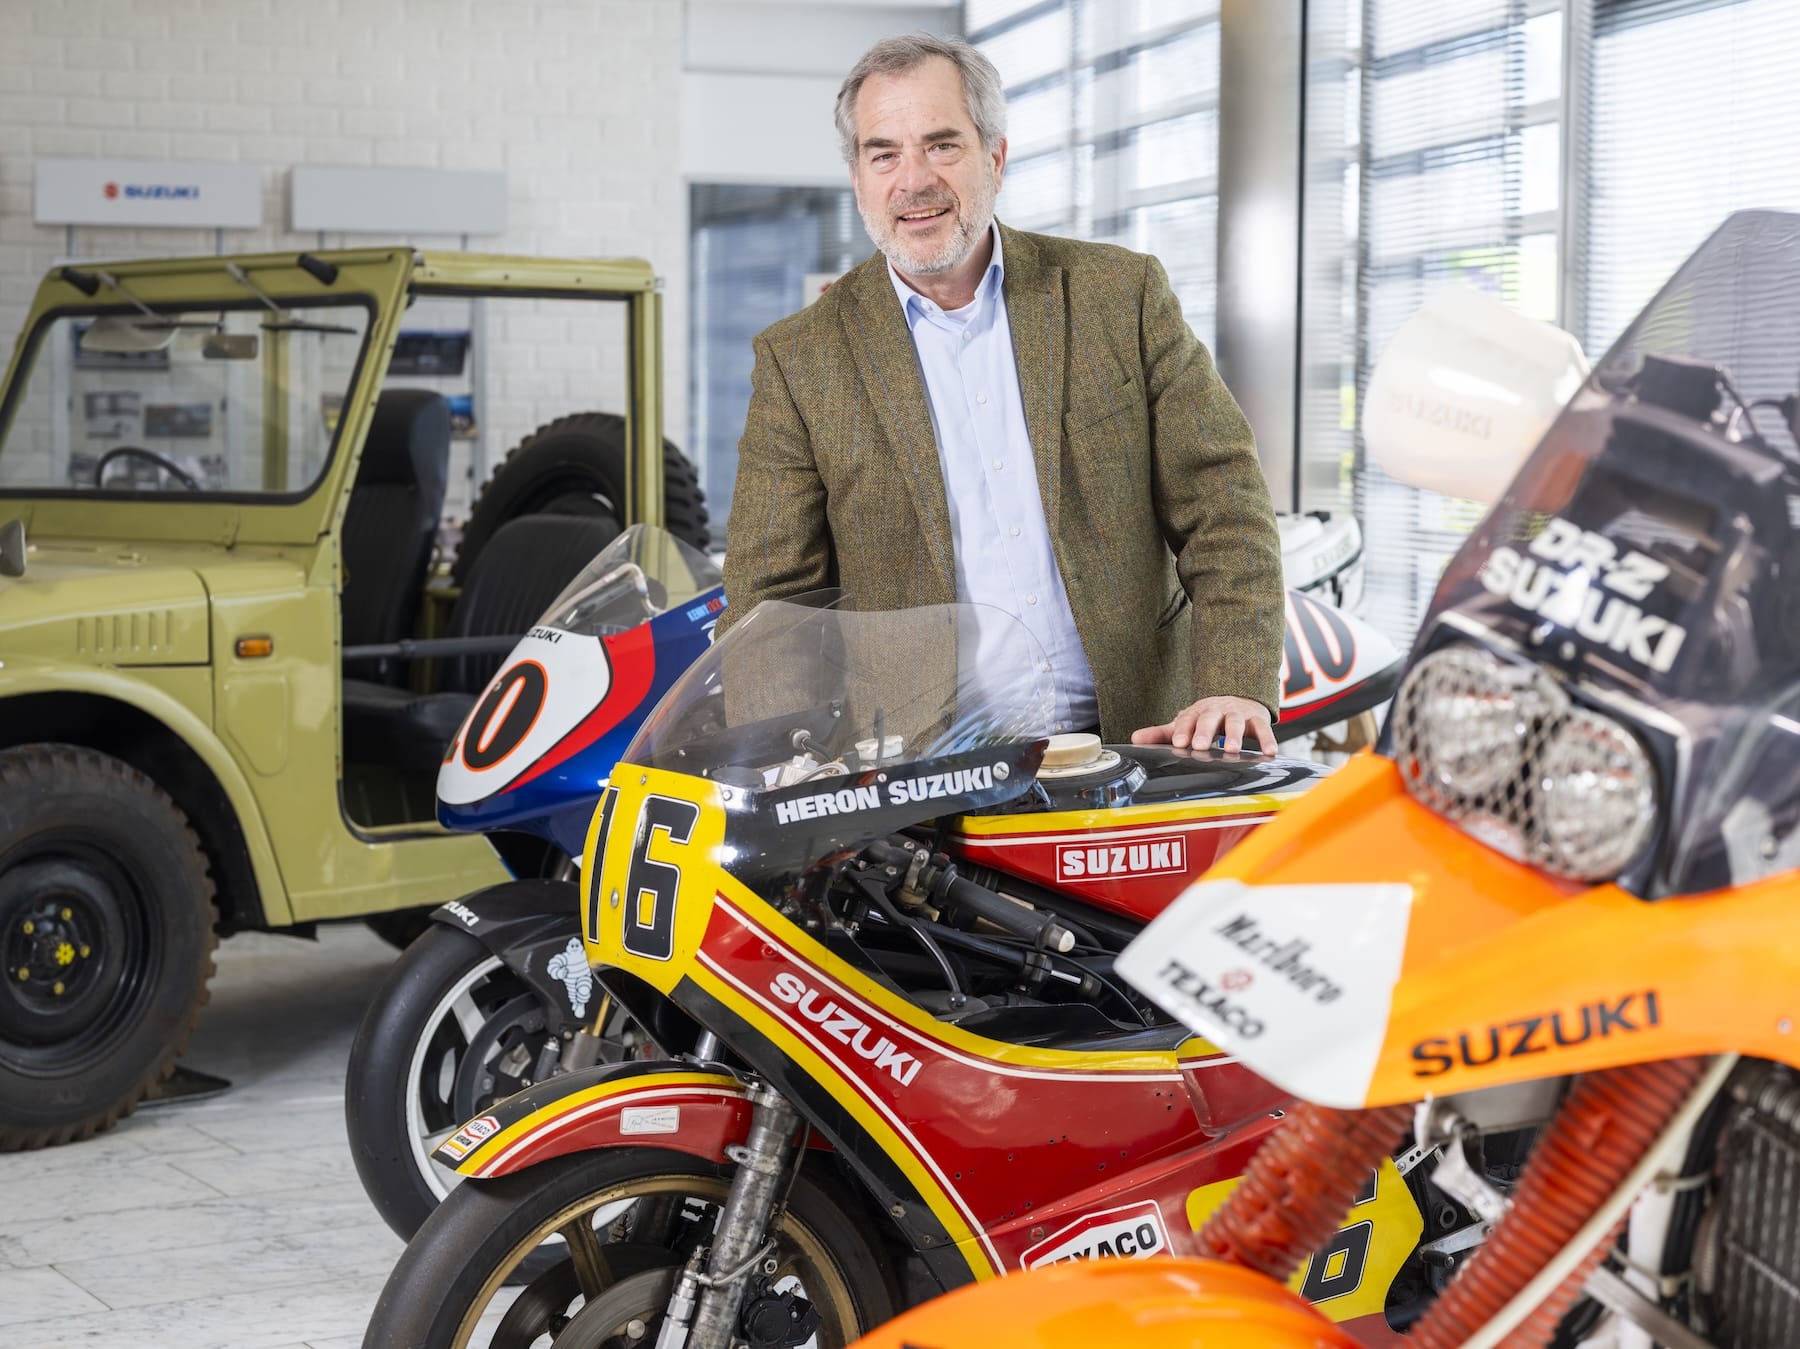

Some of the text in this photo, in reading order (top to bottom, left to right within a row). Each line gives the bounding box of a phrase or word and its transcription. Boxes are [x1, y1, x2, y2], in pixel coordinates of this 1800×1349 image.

[1480, 546, 1687, 673] SUZUKI
[775, 765, 994, 825] HERON SUZUKI
[587, 786, 701, 961] 16
[1063, 841, 1182, 876] SUZUKI
[1157, 960, 1265, 1039] TEXACO
[1215, 913, 1343, 1003] Marlboro
[769, 972, 923, 1087] SUZUKI
[1411, 990, 1659, 1077] SUZUKI
